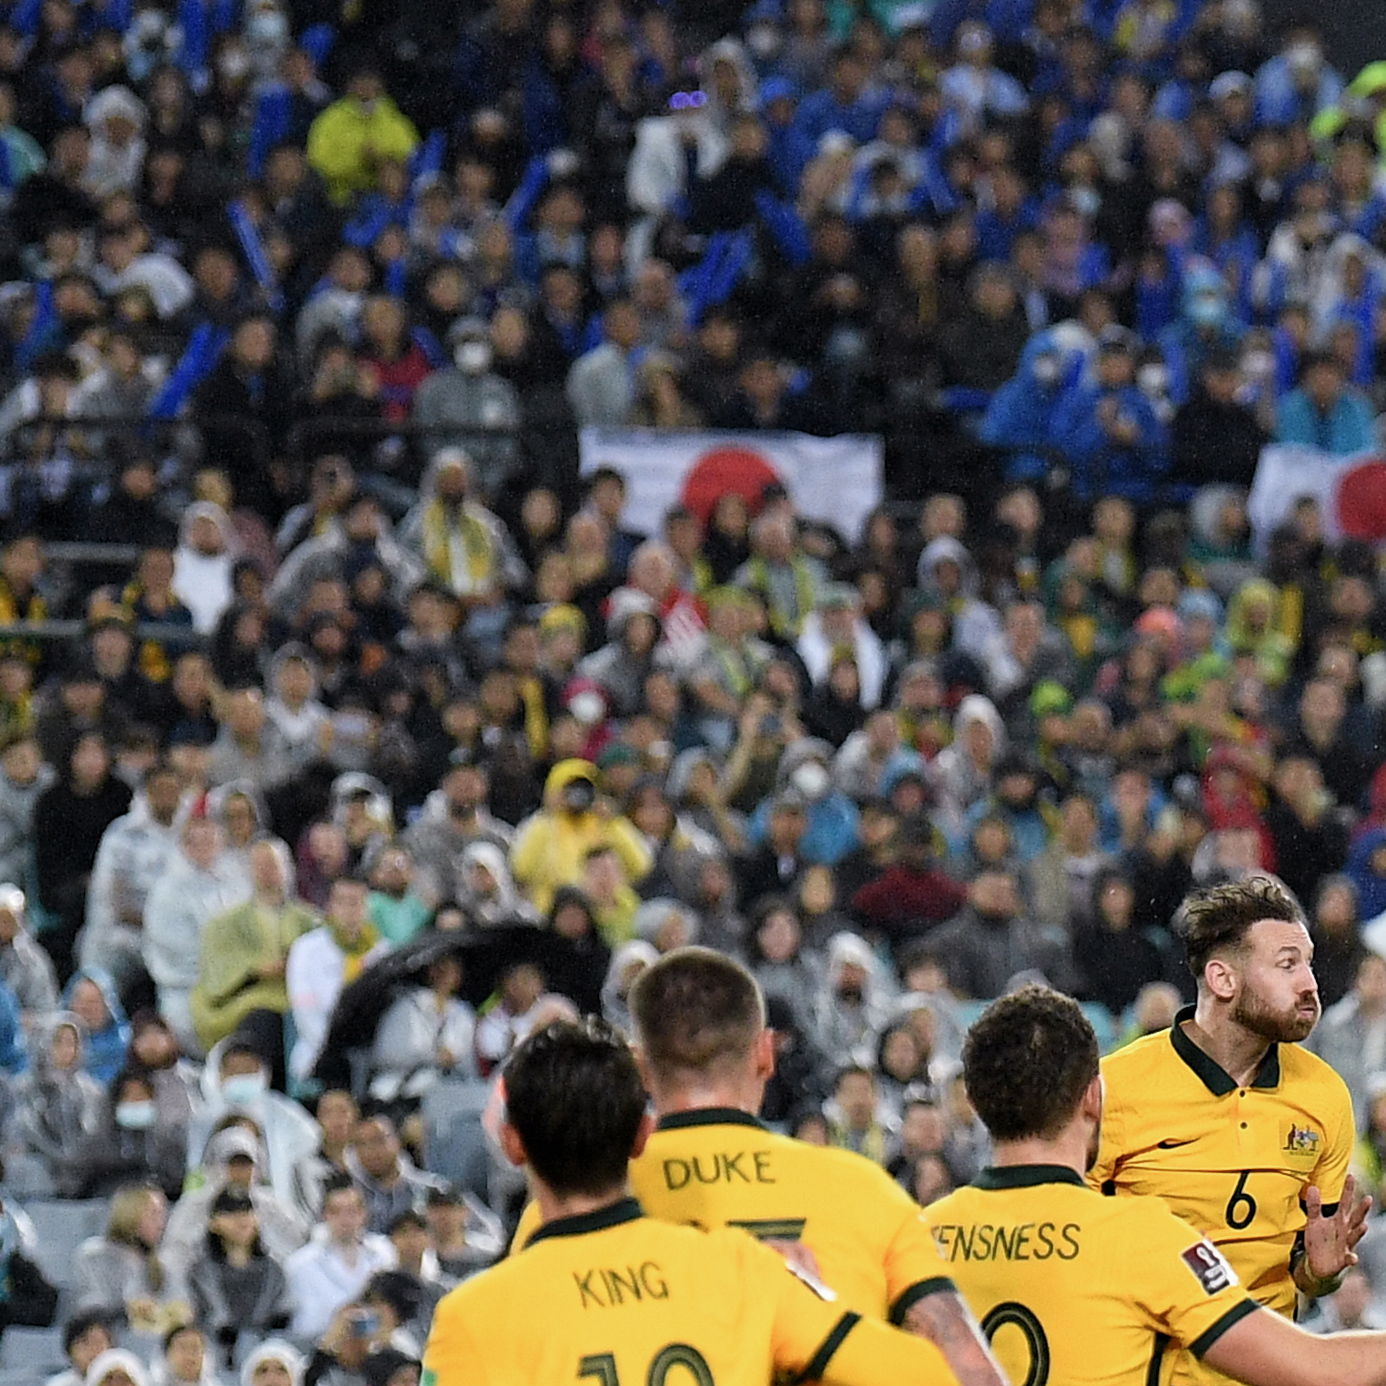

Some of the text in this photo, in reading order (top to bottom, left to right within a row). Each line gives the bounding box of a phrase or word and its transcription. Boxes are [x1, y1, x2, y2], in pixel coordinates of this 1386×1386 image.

[662, 1151, 776, 1191] DUKE
[1224, 1169, 1258, 1231] 6
[931, 1221, 1082, 1262] ENSNESS
[572, 1260, 670, 1310] KING
